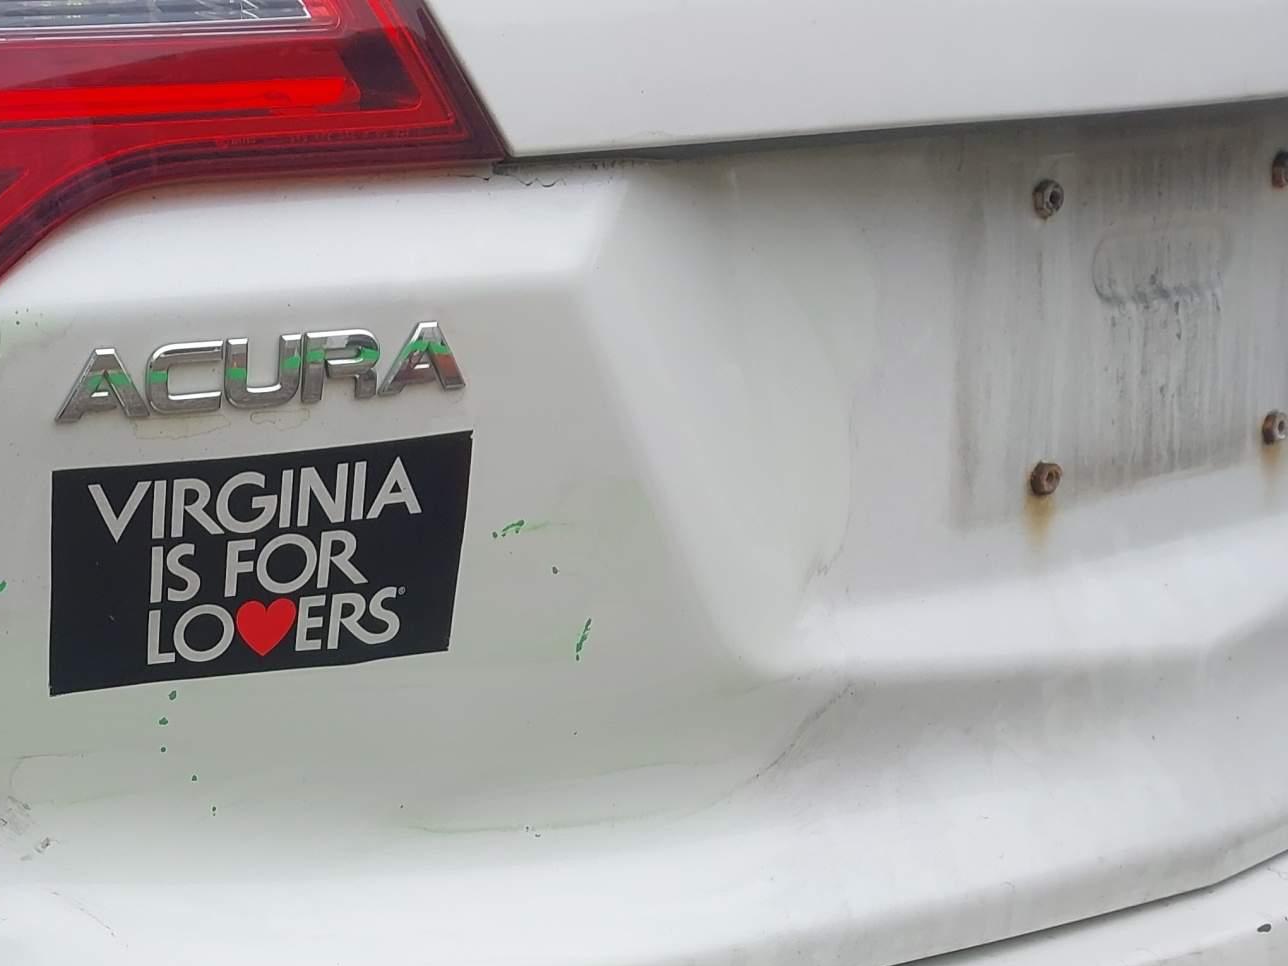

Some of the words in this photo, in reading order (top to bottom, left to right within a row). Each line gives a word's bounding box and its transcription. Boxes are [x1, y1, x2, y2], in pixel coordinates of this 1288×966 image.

[54, 320, 466, 424] ACURA
[87, 456, 422, 543] VIRGINIA
[150, 543, 201, 603] IS
[223, 529, 368, 597] FOR
